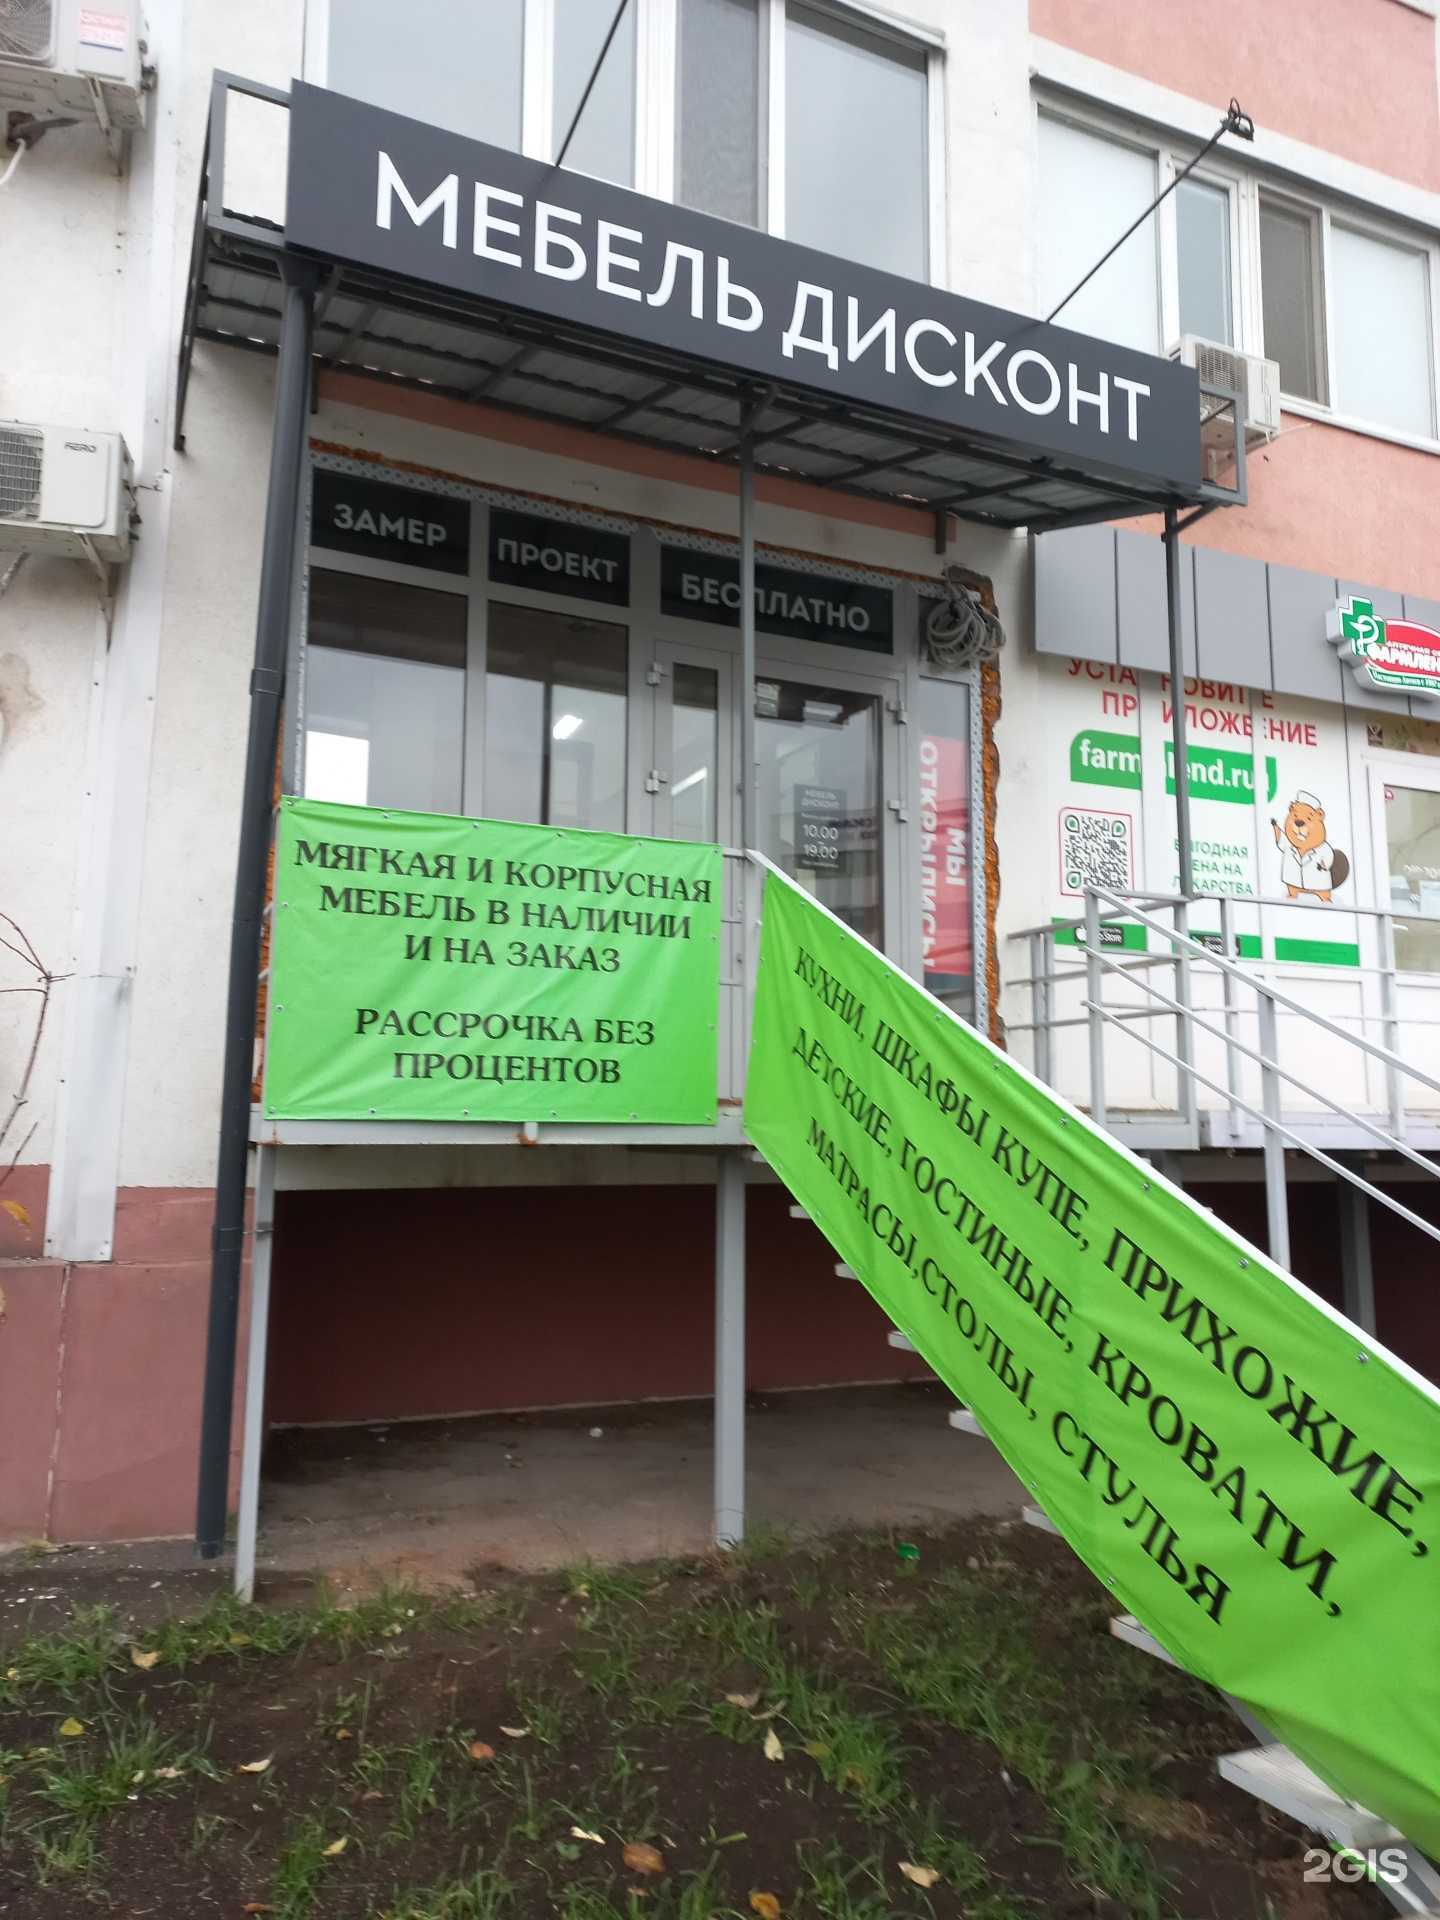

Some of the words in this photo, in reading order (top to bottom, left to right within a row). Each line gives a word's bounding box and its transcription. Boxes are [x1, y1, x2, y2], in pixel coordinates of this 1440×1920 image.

[376, 150, 764, 333] МЕБЕЛЬ
[782, 280, 1151, 442] ДИСКОНТ
[333, 503, 446, 546] ЗАМЕР
[498, 538, 618, 583] ПРОЕКТ
[681, 573, 870, 632] БЕСПЛАТНО
[1080, 738, 1269, 790] farmlnd.ru
[294, 839, 456, 880] МЯГКАЯ
[467, 856, 493, 884] И
[505, 860, 712, 903] КОРПУСНАЯ
[944, 826, 967, 887] МЫ
[1174, 839, 1248, 858] ВГОДНАЯ
[1190, 860, 1219, 873] ЕНА
[1224, 863, 1242, 875] НА
[320, 885, 475, 922] МЕБЕЛЬ
[487, 900, 509, 925] В
[522, 903, 690, 939] НАЛИЧИИ
[404, 935, 432, 961] И
[444, 937, 495, 965] НА
[507, 941, 621, 973] ЗАКАЗ
[355, 1008, 583, 1043] РАССРОЧКА
[593, 1019, 655, 1046] БЕЗ
[393, 1052, 621, 1085] ПРОЦЕНТОВ
[794, 947, 866, 1040] КУХНИ,
[872, 1020, 990, 1147] ШКАФЫ
[992, 1126, 1089, 1251] КУПЕ,
[1103, 1227, 1430, 1558] ПРИХОЖИЕ,
[793, 1027, 892, 1158] ДЕТСКИЕ,
[900, 1137, 1074, 1352] ГОСТИНЫЕ,
[1088, 1332, 1342, 1617] КРОВАТИ,
[1052, 1411, 1232, 1625] СТУЛЬЯ
